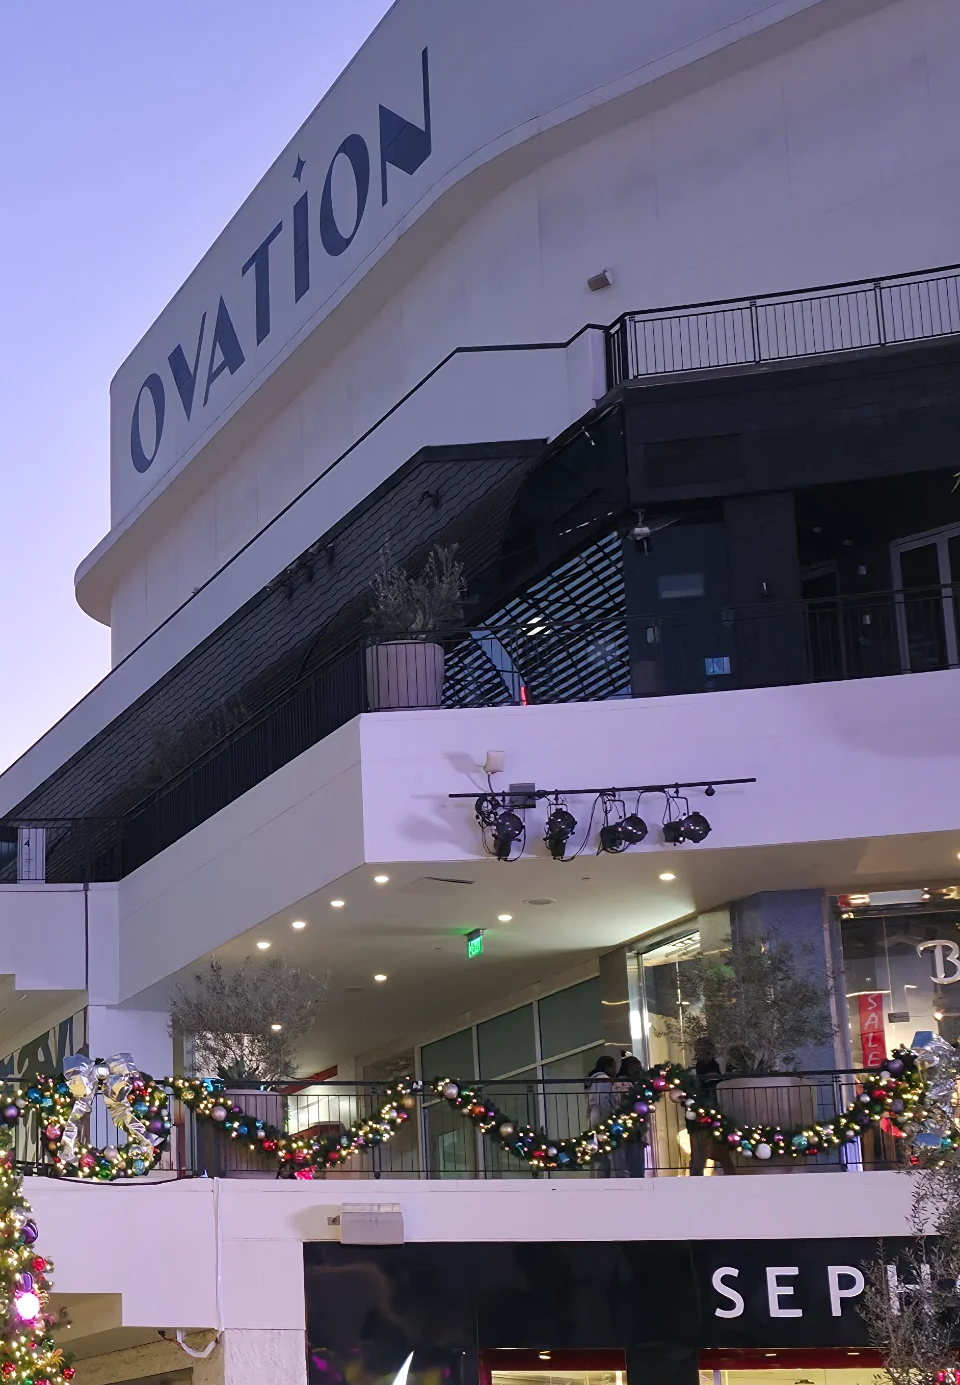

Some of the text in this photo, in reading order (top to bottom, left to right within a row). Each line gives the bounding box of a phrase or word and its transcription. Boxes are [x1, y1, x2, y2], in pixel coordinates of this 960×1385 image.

[130, 46, 432, 474] OVATION
[916, 939, 960, 985] B
[864, 994, 882, 1067] SALE
[711, 1264, 960, 1319] SEPH
